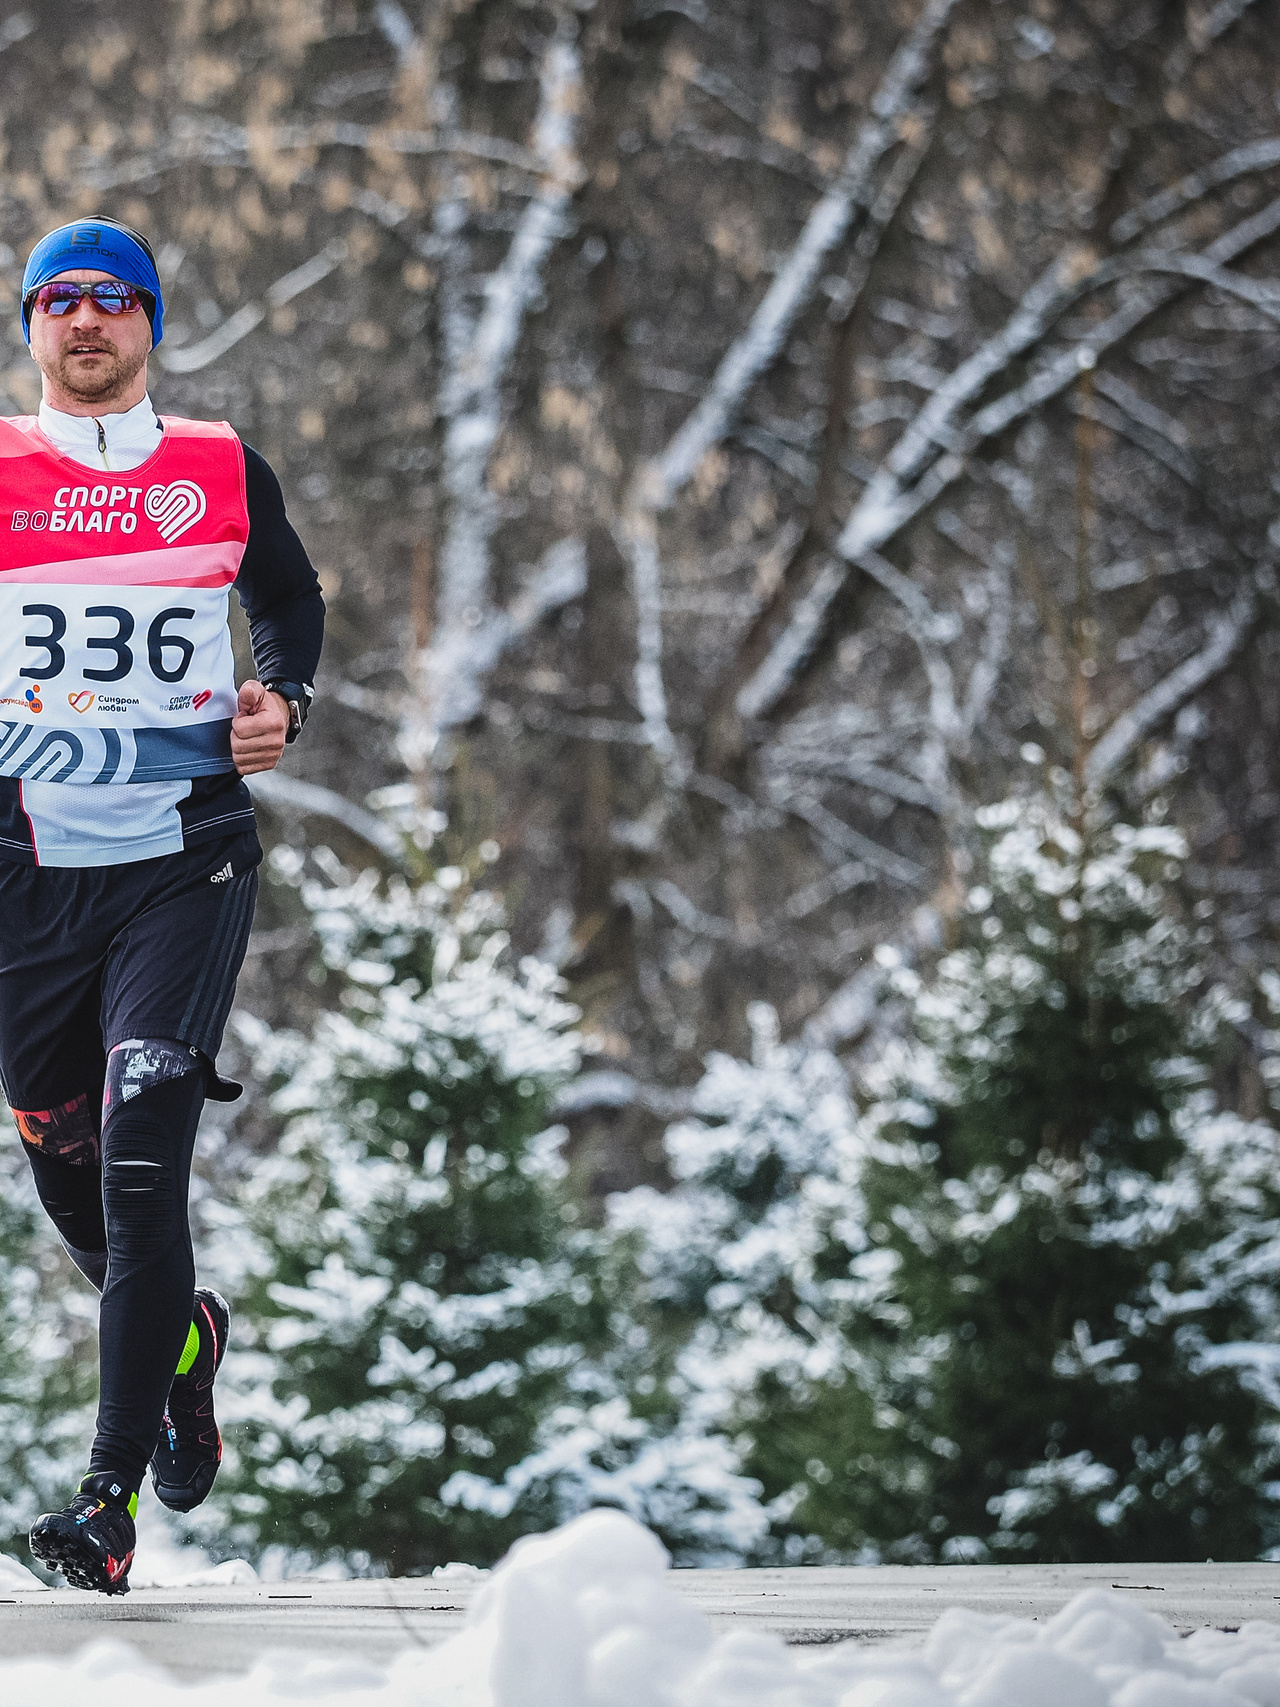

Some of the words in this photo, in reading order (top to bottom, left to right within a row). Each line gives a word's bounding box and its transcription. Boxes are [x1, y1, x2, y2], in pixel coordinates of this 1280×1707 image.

[53, 485, 143, 509] СПОРТ
[19, 603, 196, 683] 336
[98, 694, 140, 705] Синдром
[169, 694, 193, 704] СПОРТ
[97, 704, 127, 712] любви
